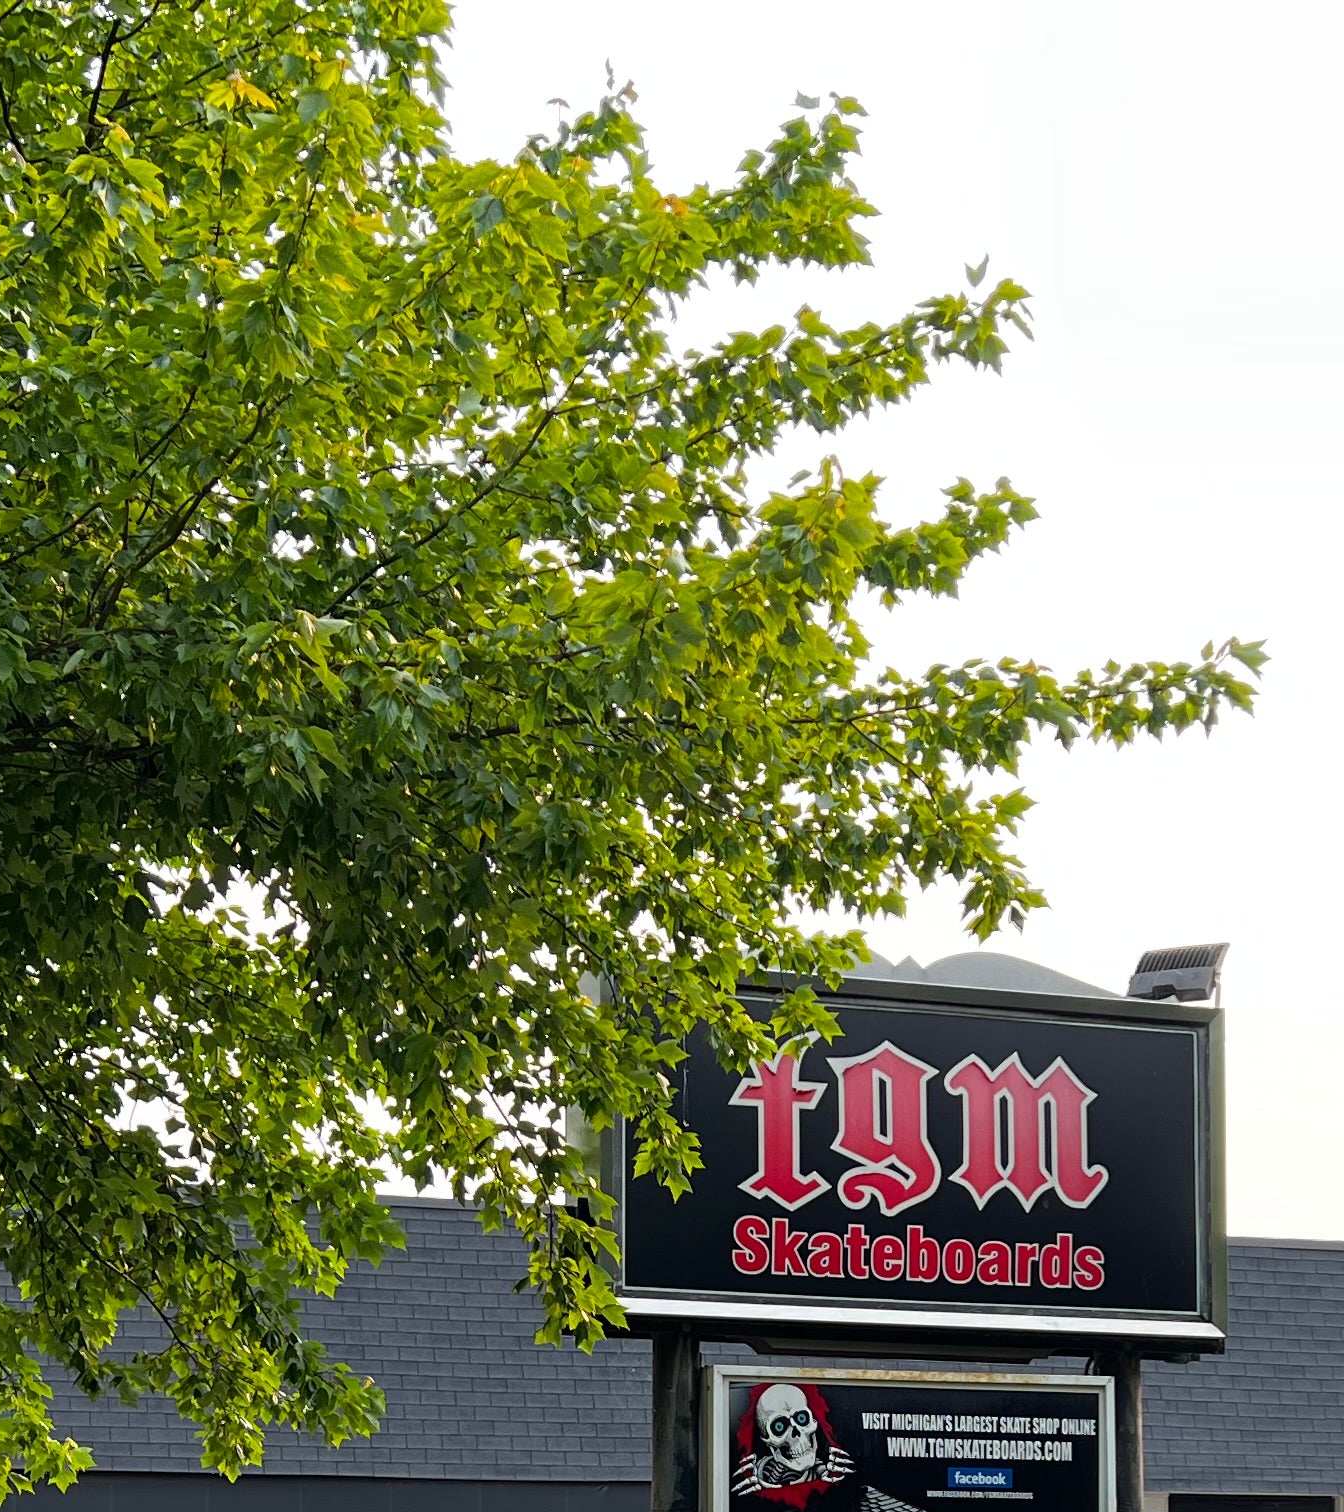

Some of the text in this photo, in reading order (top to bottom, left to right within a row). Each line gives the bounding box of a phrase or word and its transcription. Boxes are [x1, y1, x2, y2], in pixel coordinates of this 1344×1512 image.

[728, 1031, 1109, 1216] tgm
[731, 1214, 1106, 1290] Skateboards
[861, 1412, 1096, 1436] VISIT MICHIGAN'S LARGEST SKATE SHOP ONLINE
[886, 1436, 1073, 1462] WWW.TGMSKATEBOARDS.COM
[954, 1470, 1007, 1485] facebook
